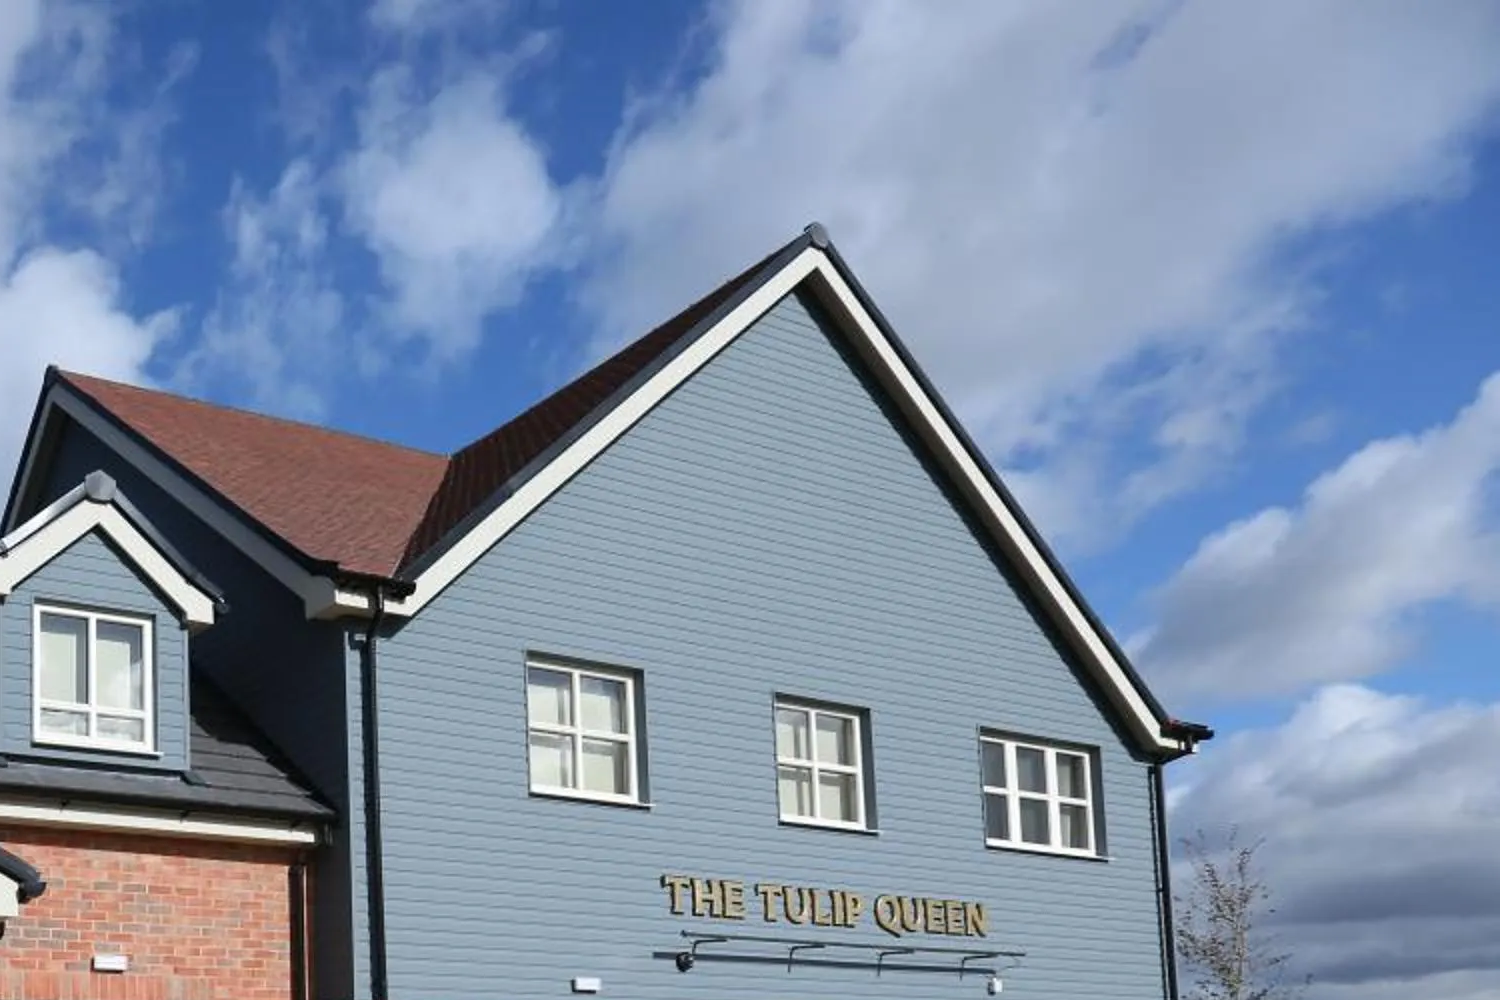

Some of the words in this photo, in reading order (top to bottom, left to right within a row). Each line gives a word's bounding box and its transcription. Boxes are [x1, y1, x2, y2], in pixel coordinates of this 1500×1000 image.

[660, 874, 746, 920] THE
[755, 883, 865, 928] TULIP
[874, 895, 990, 938] QUEEN
